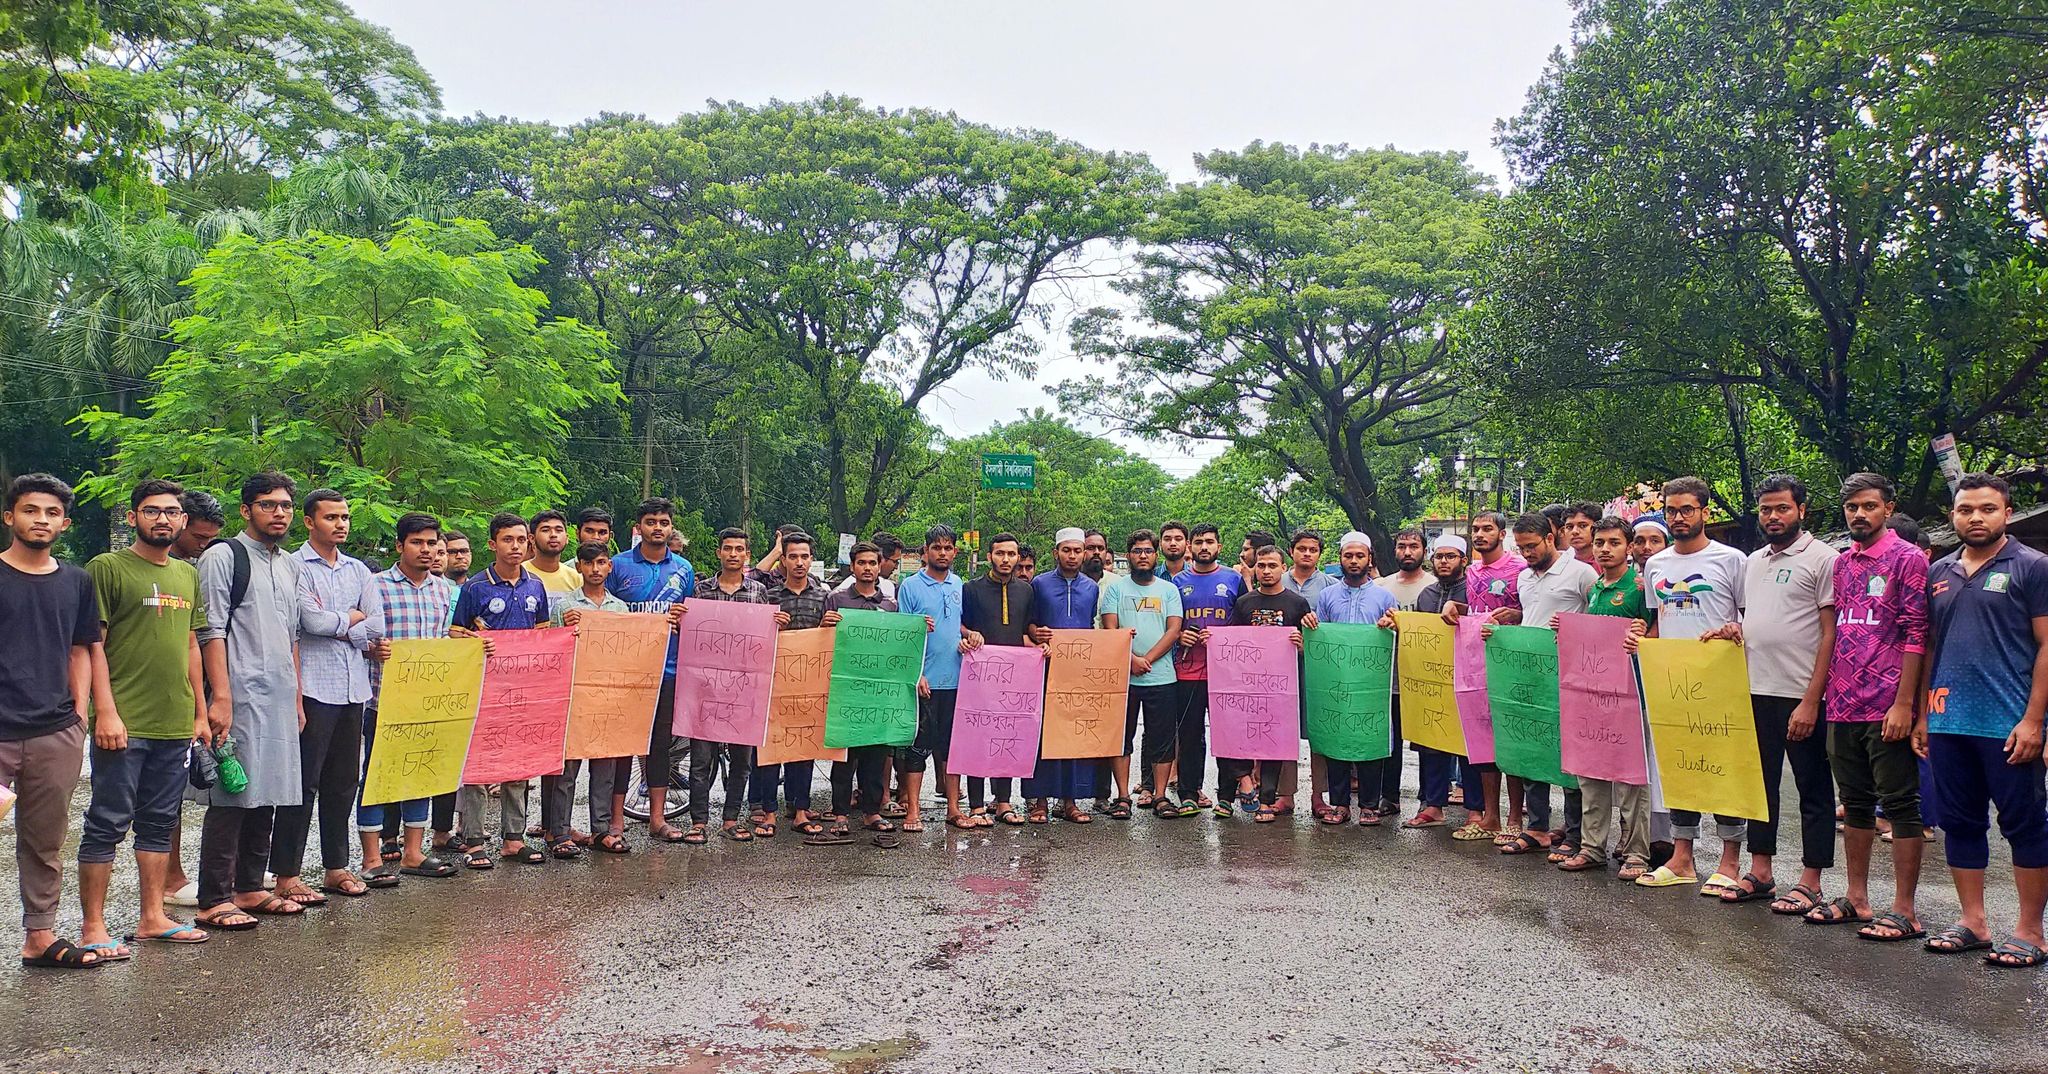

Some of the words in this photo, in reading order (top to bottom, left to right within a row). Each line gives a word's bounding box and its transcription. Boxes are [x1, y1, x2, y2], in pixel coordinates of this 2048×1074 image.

[688, 620, 766, 664] নিরাপদ
[847, 625, 890, 643] আমার
[894, 627, 923, 652] ভাই
[1216, 637, 1266, 664] ট্রাফিক
[1402, 624, 1445, 651] ট্রাফিক
[394, 650, 456, 683] ট্রাফিক
[1581, 643, 1608, 674] We
[702, 667, 750, 692] সড়ক
[1082, 667, 1120, 686] হত্যার
[1242, 669, 1289, 692] আইনের
[1667, 667, 1707, 701] We
[422, 687, 469, 716] আইনের
[999, 690, 1038, 712] হত্যার
[1586, 682, 1620, 710] Want
[700, 691, 750, 734] চাই
[881, 703, 914, 728] চাই
[1423, 704, 1449, 736] চাই
[1686, 712, 1736, 738] Want
[785, 718, 824, 751] চাই
[1071, 712, 1103, 743] চাই
[1247, 714, 1281, 746] চাই
[1578, 717, 1628, 745] Justice
[402, 739, 444, 776] চাই
[989, 732, 1025, 761] চাই
[1676, 749, 1726, 777] Justice
